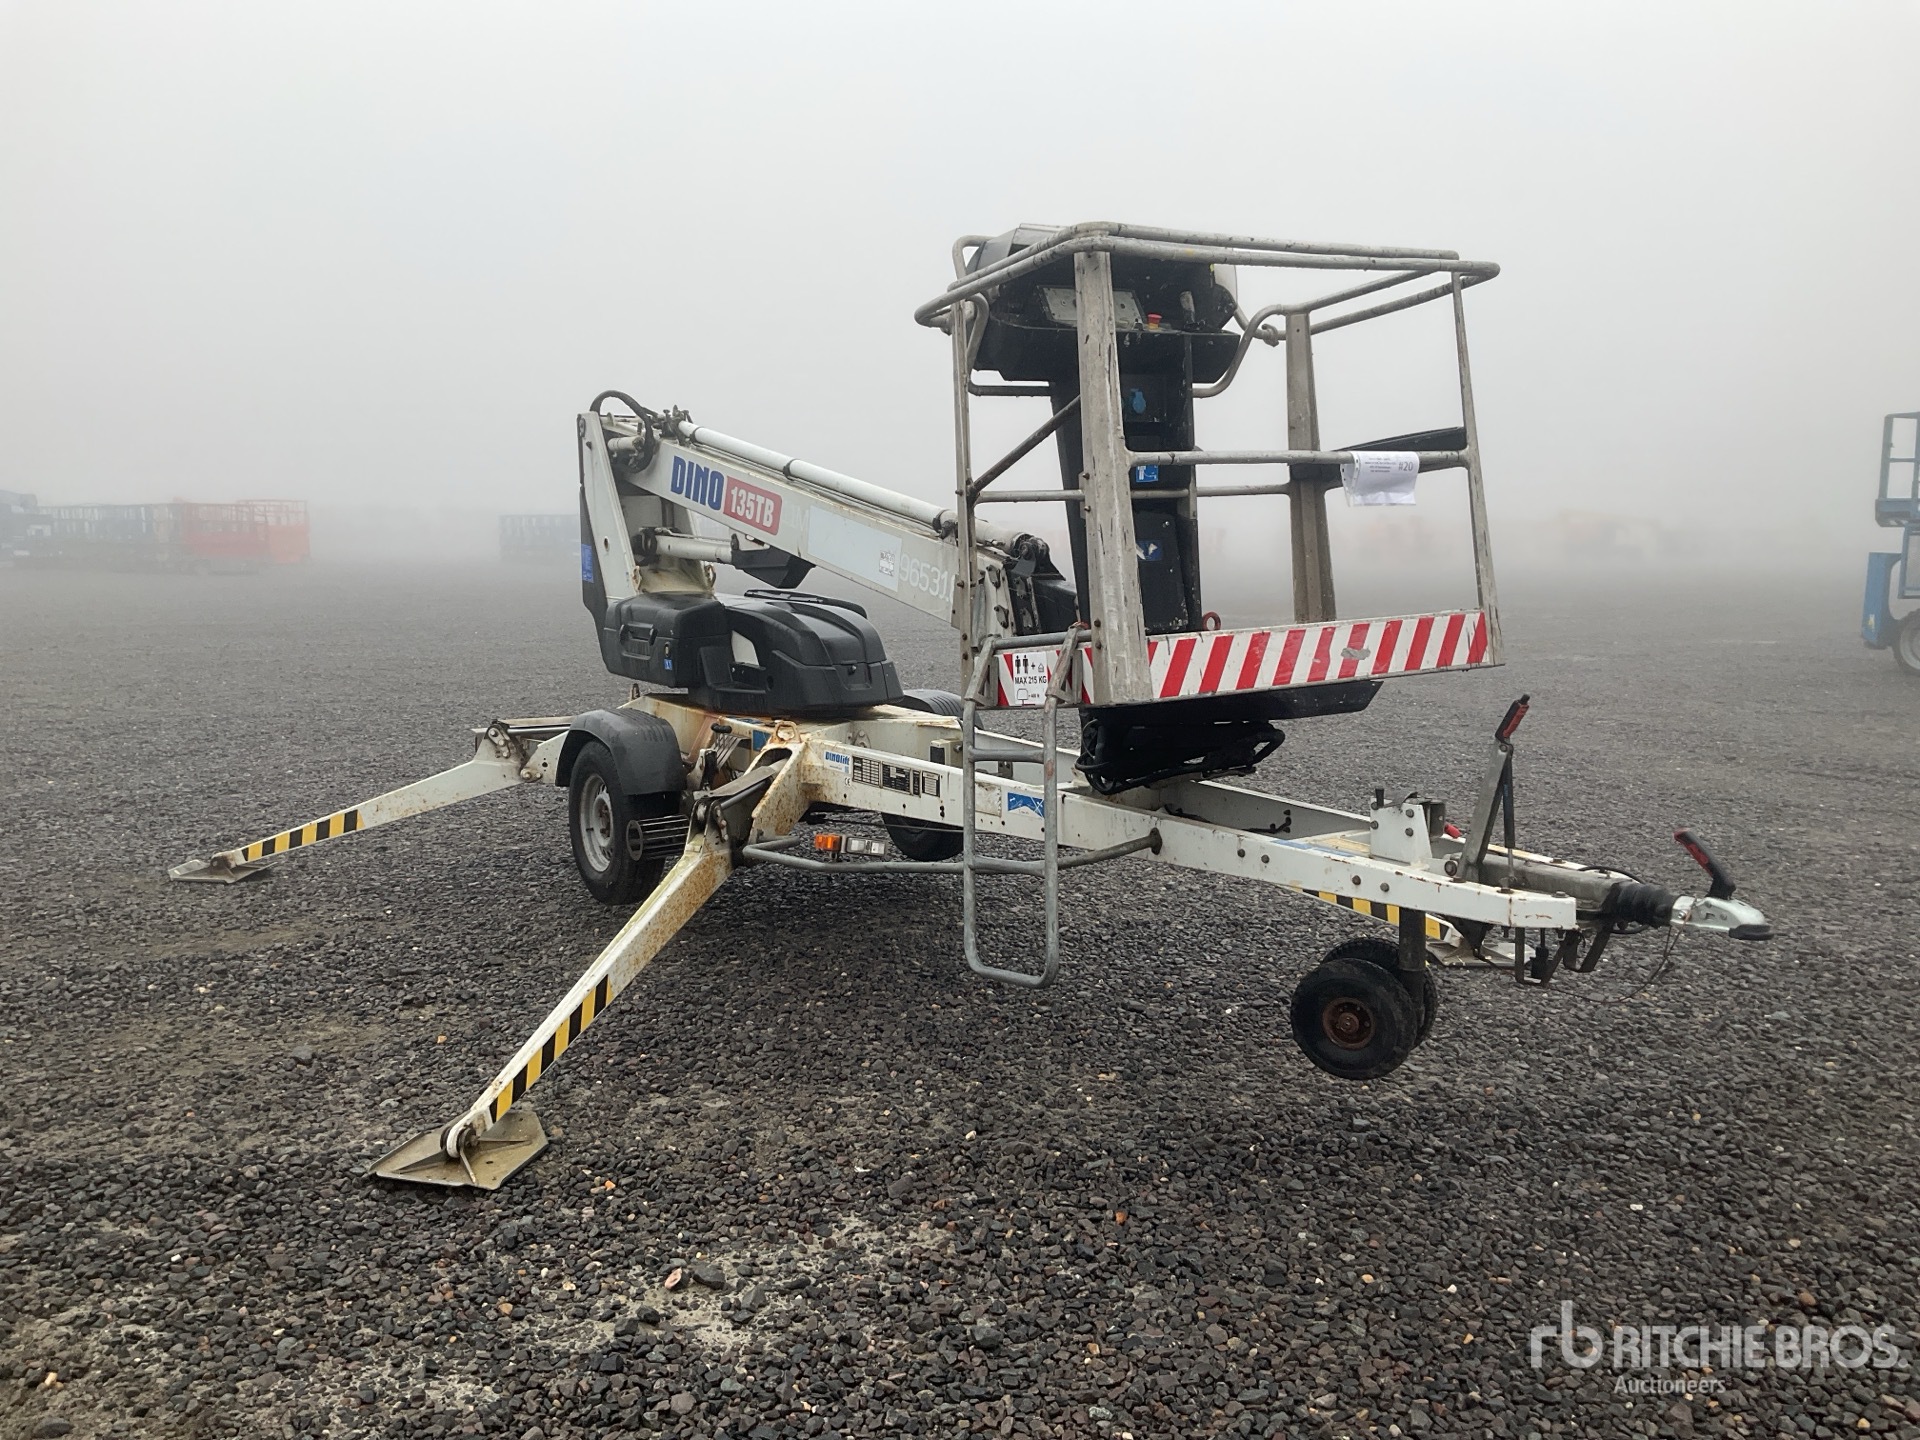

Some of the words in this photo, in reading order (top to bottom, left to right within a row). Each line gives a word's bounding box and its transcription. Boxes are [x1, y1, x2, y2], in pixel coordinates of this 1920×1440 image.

[1398, 462, 1413, 471] #20
[671, 455, 724, 510] DINO
[730, 486, 775, 528] 135TB
[1015, 676, 1028, 685] MAX
[1028, 676, 1038, 685] 215
[1039, 675, 1047, 684] KG
